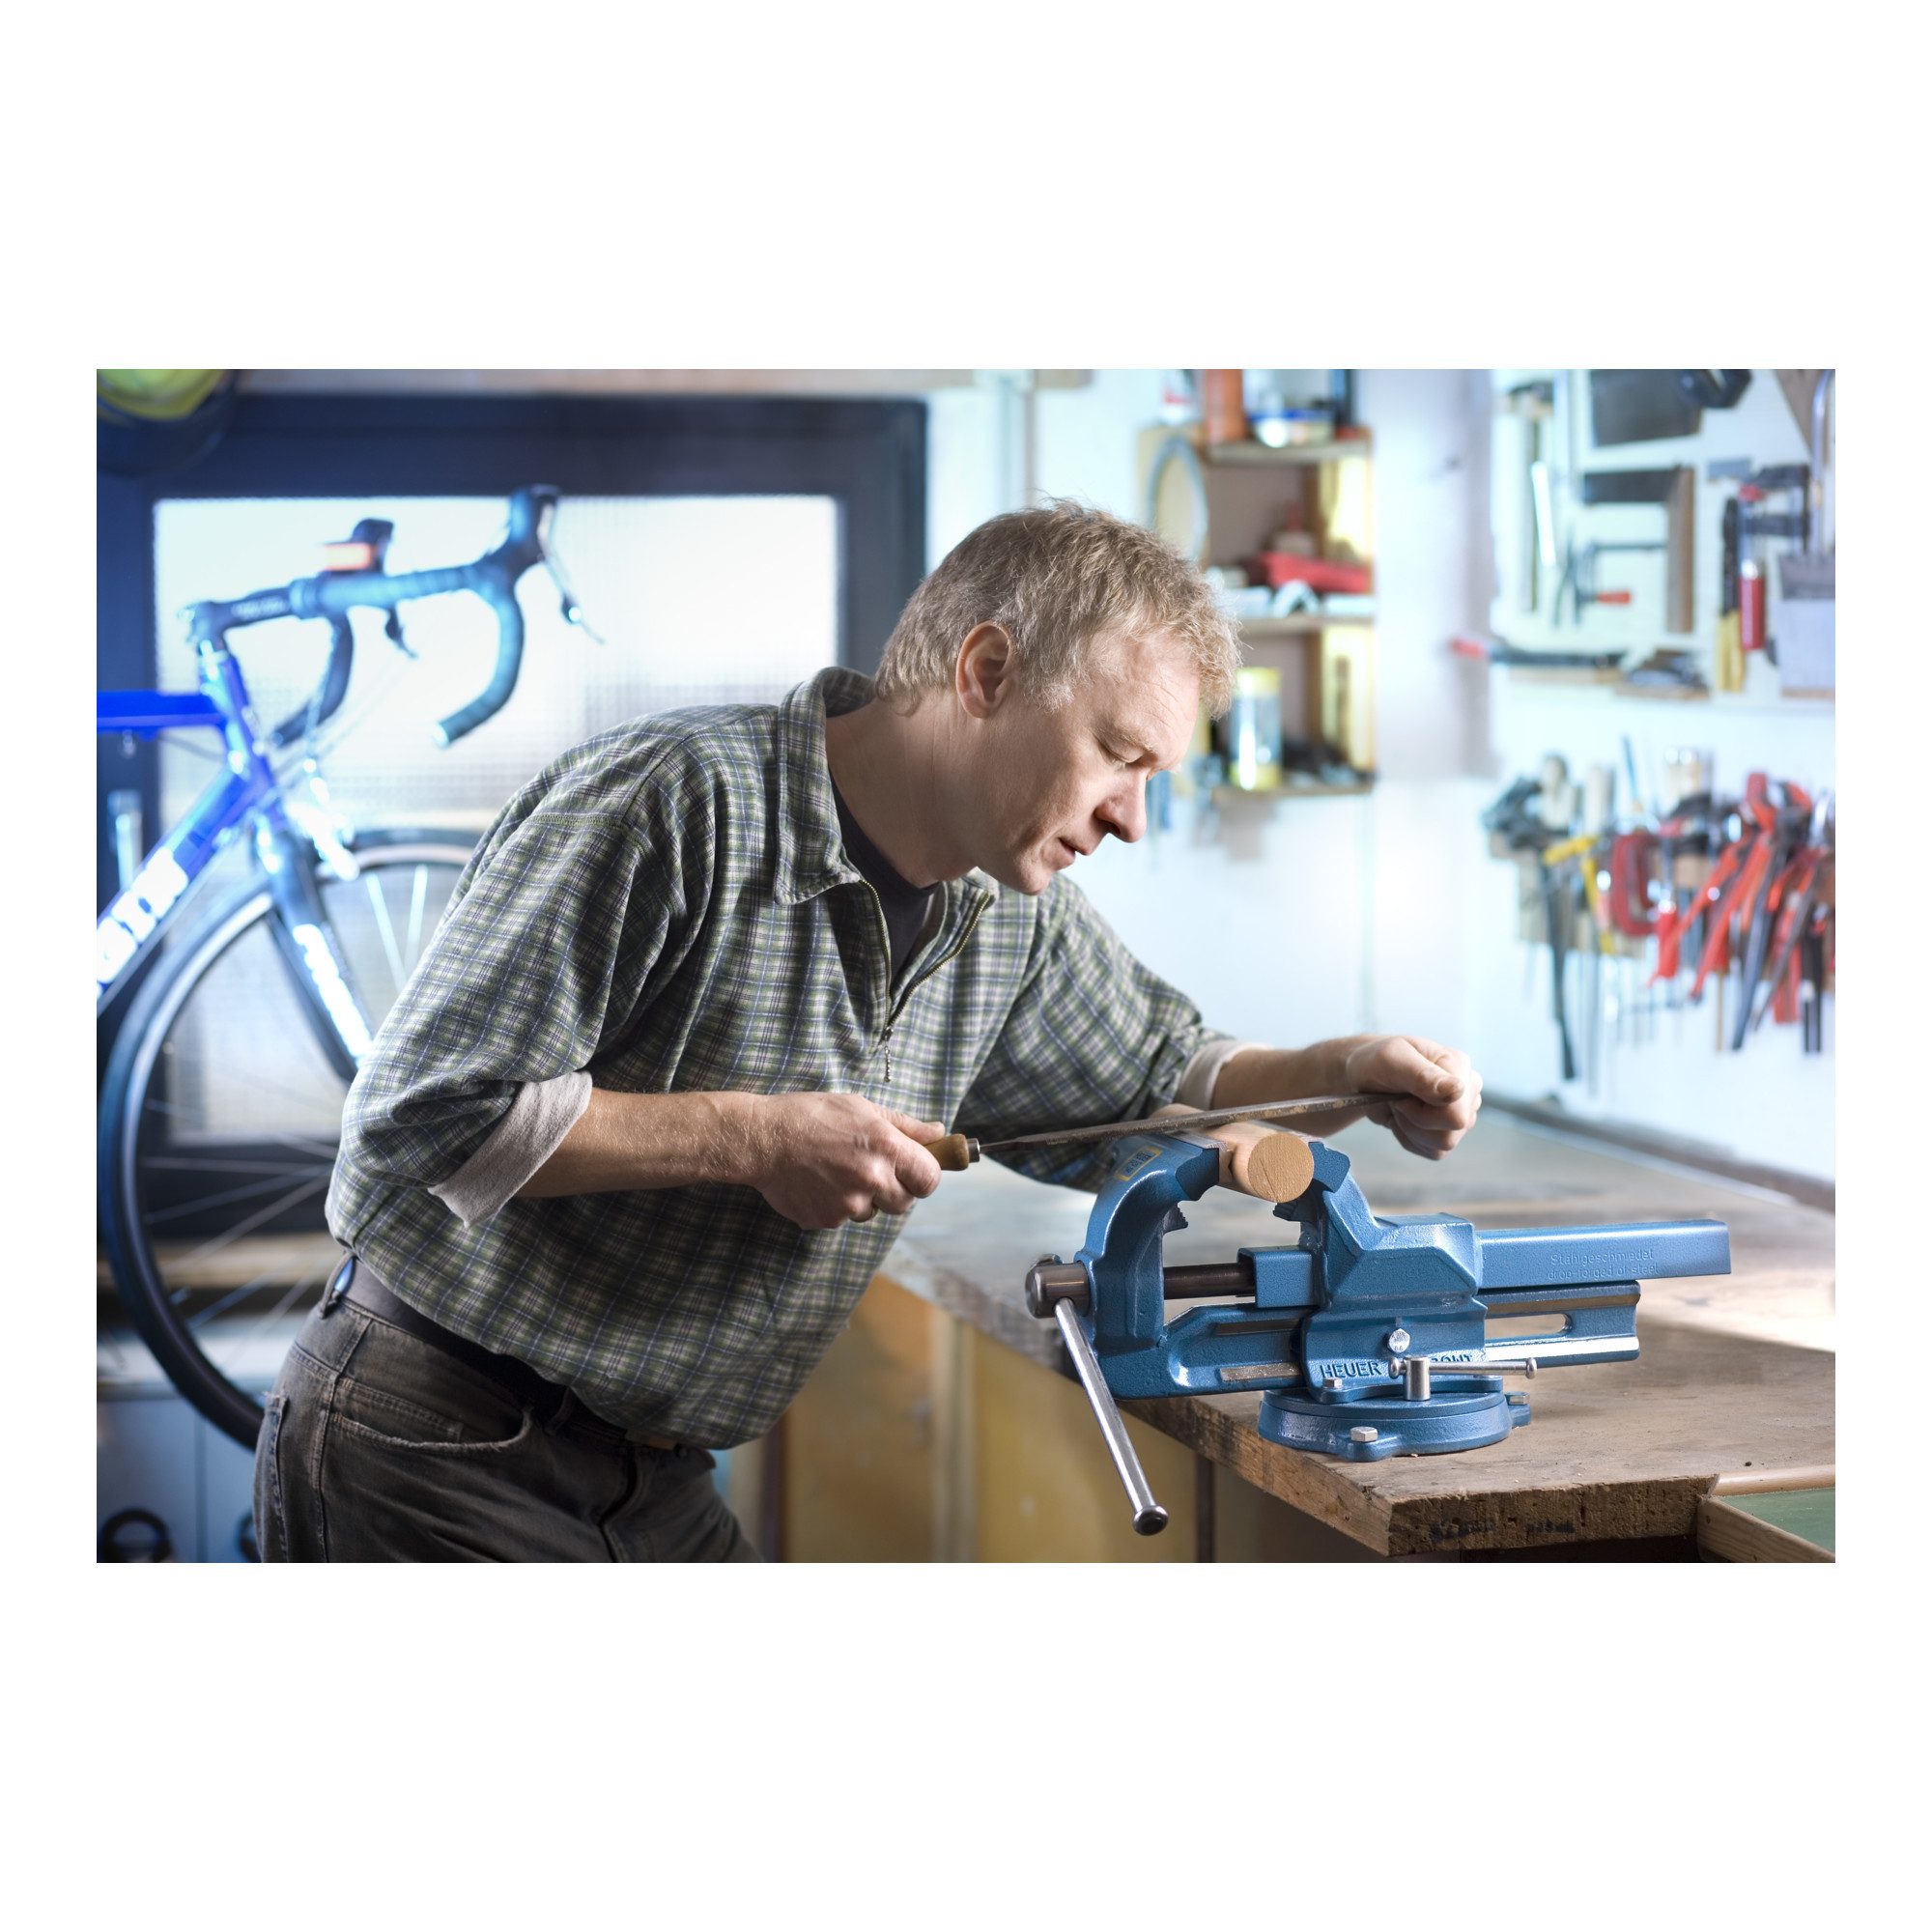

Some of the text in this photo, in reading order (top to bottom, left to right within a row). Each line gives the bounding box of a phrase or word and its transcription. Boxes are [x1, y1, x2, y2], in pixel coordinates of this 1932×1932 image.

[1550, 1249, 1654, 1266] Stahlgeschmiedet
[1631, 1262, 1659, 1275] steel
[1320, 1361, 1382, 1378] HEUER
